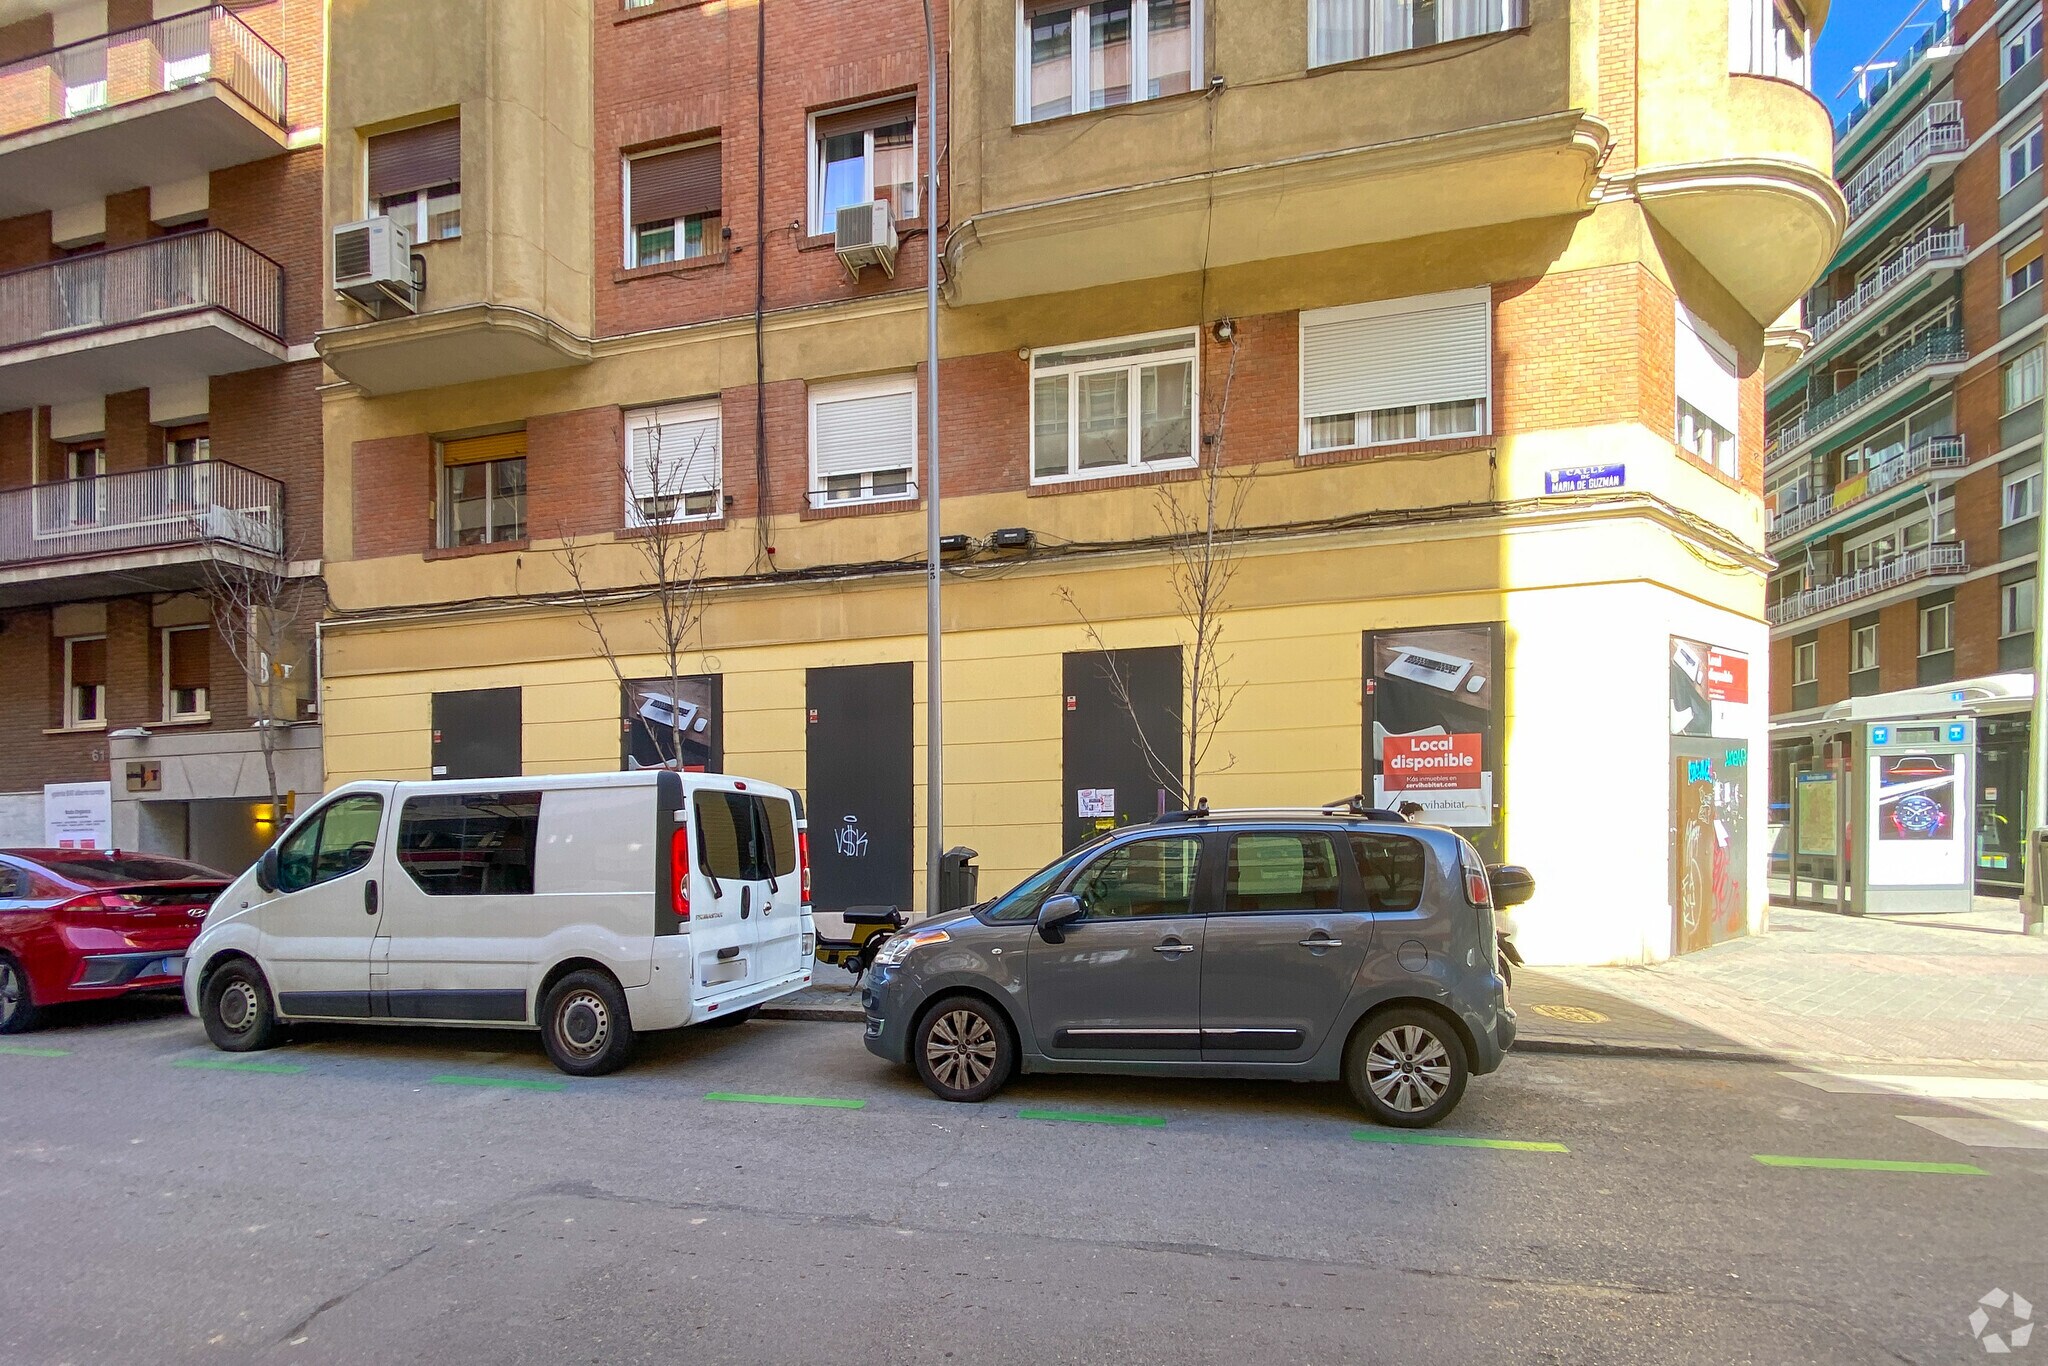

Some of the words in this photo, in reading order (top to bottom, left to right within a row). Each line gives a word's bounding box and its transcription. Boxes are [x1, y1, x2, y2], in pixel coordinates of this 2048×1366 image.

[1566, 466, 1606, 476] CALLE
[1577, 479, 1587, 490] DE
[1411, 736, 1453, 752] Local
[92, 749, 105, 762] 61
[1391, 753, 1473, 771] disponible
[1420, 799, 1465, 810] rvihabitat
